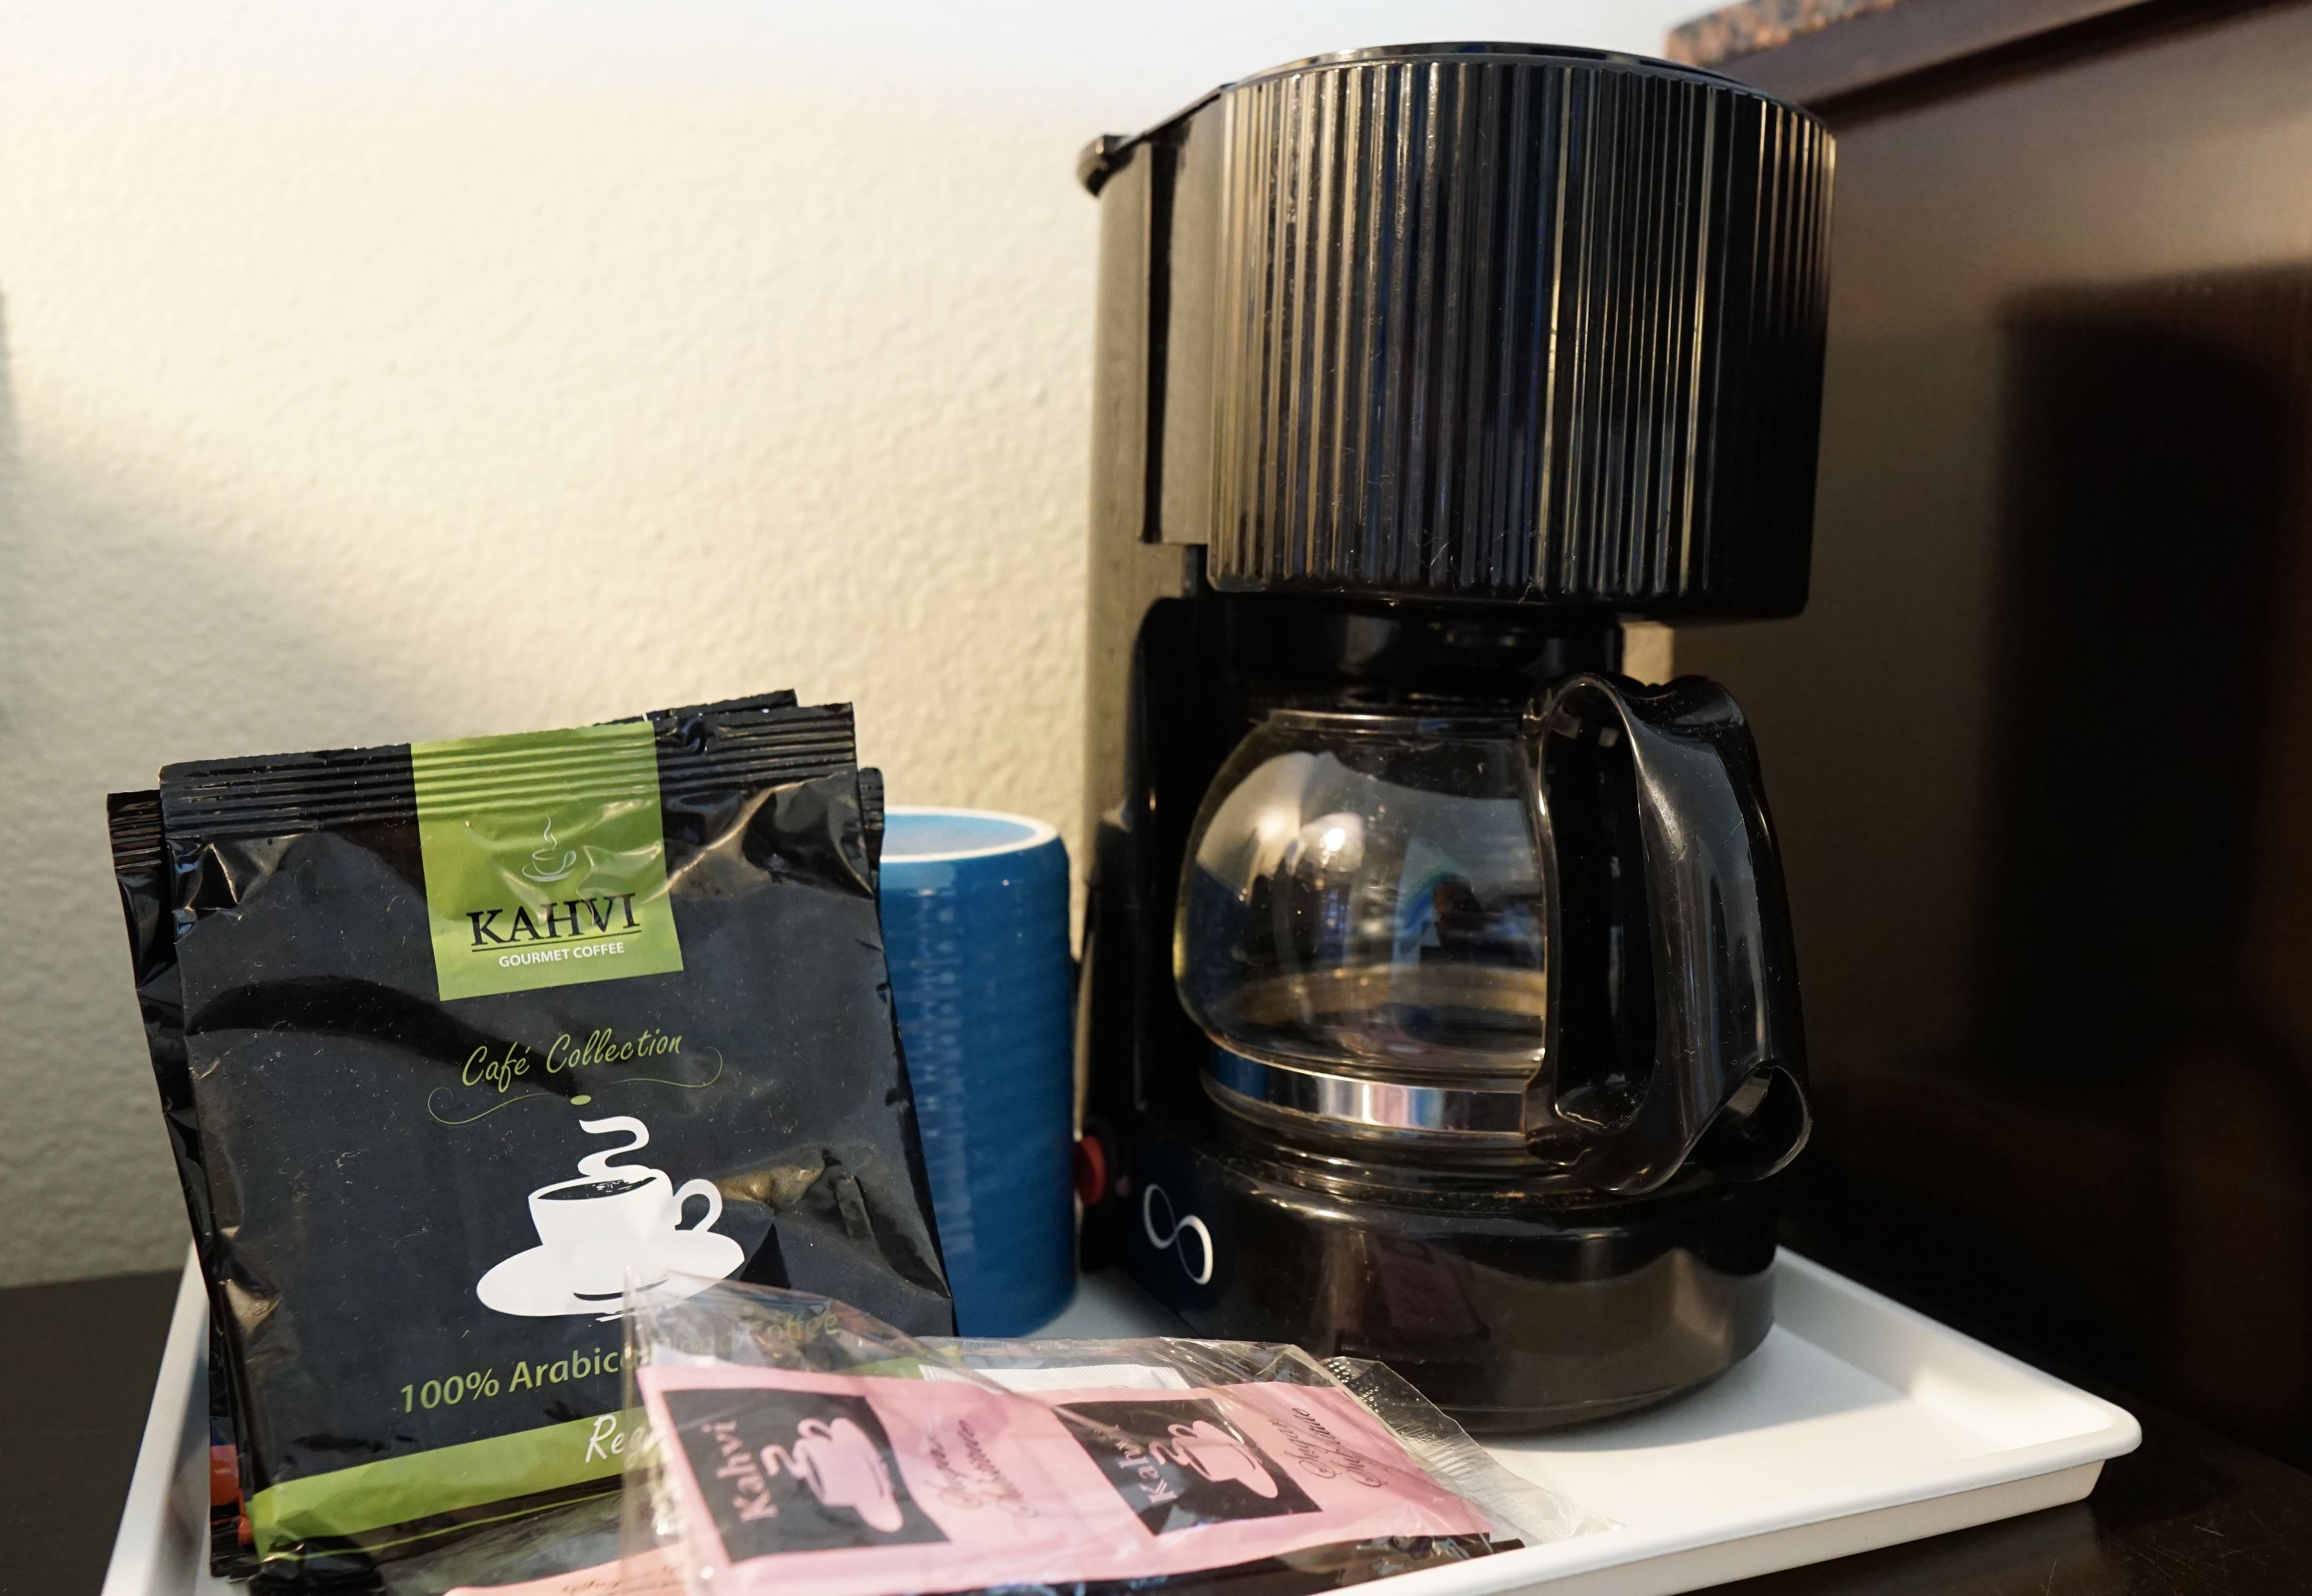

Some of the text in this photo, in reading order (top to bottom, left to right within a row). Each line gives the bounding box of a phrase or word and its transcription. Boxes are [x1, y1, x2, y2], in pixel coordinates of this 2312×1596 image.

[466, 893, 640, 945] KAHVI
[499, 942, 625, 967] GOURMET COFFEE
[462, 1028, 683, 1093] Café Collection
[400, 1368, 500, 1413] 100%
[701, 1419, 778, 1524] Kahvi
[1268, 1418, 1339, 1480] Sugar
